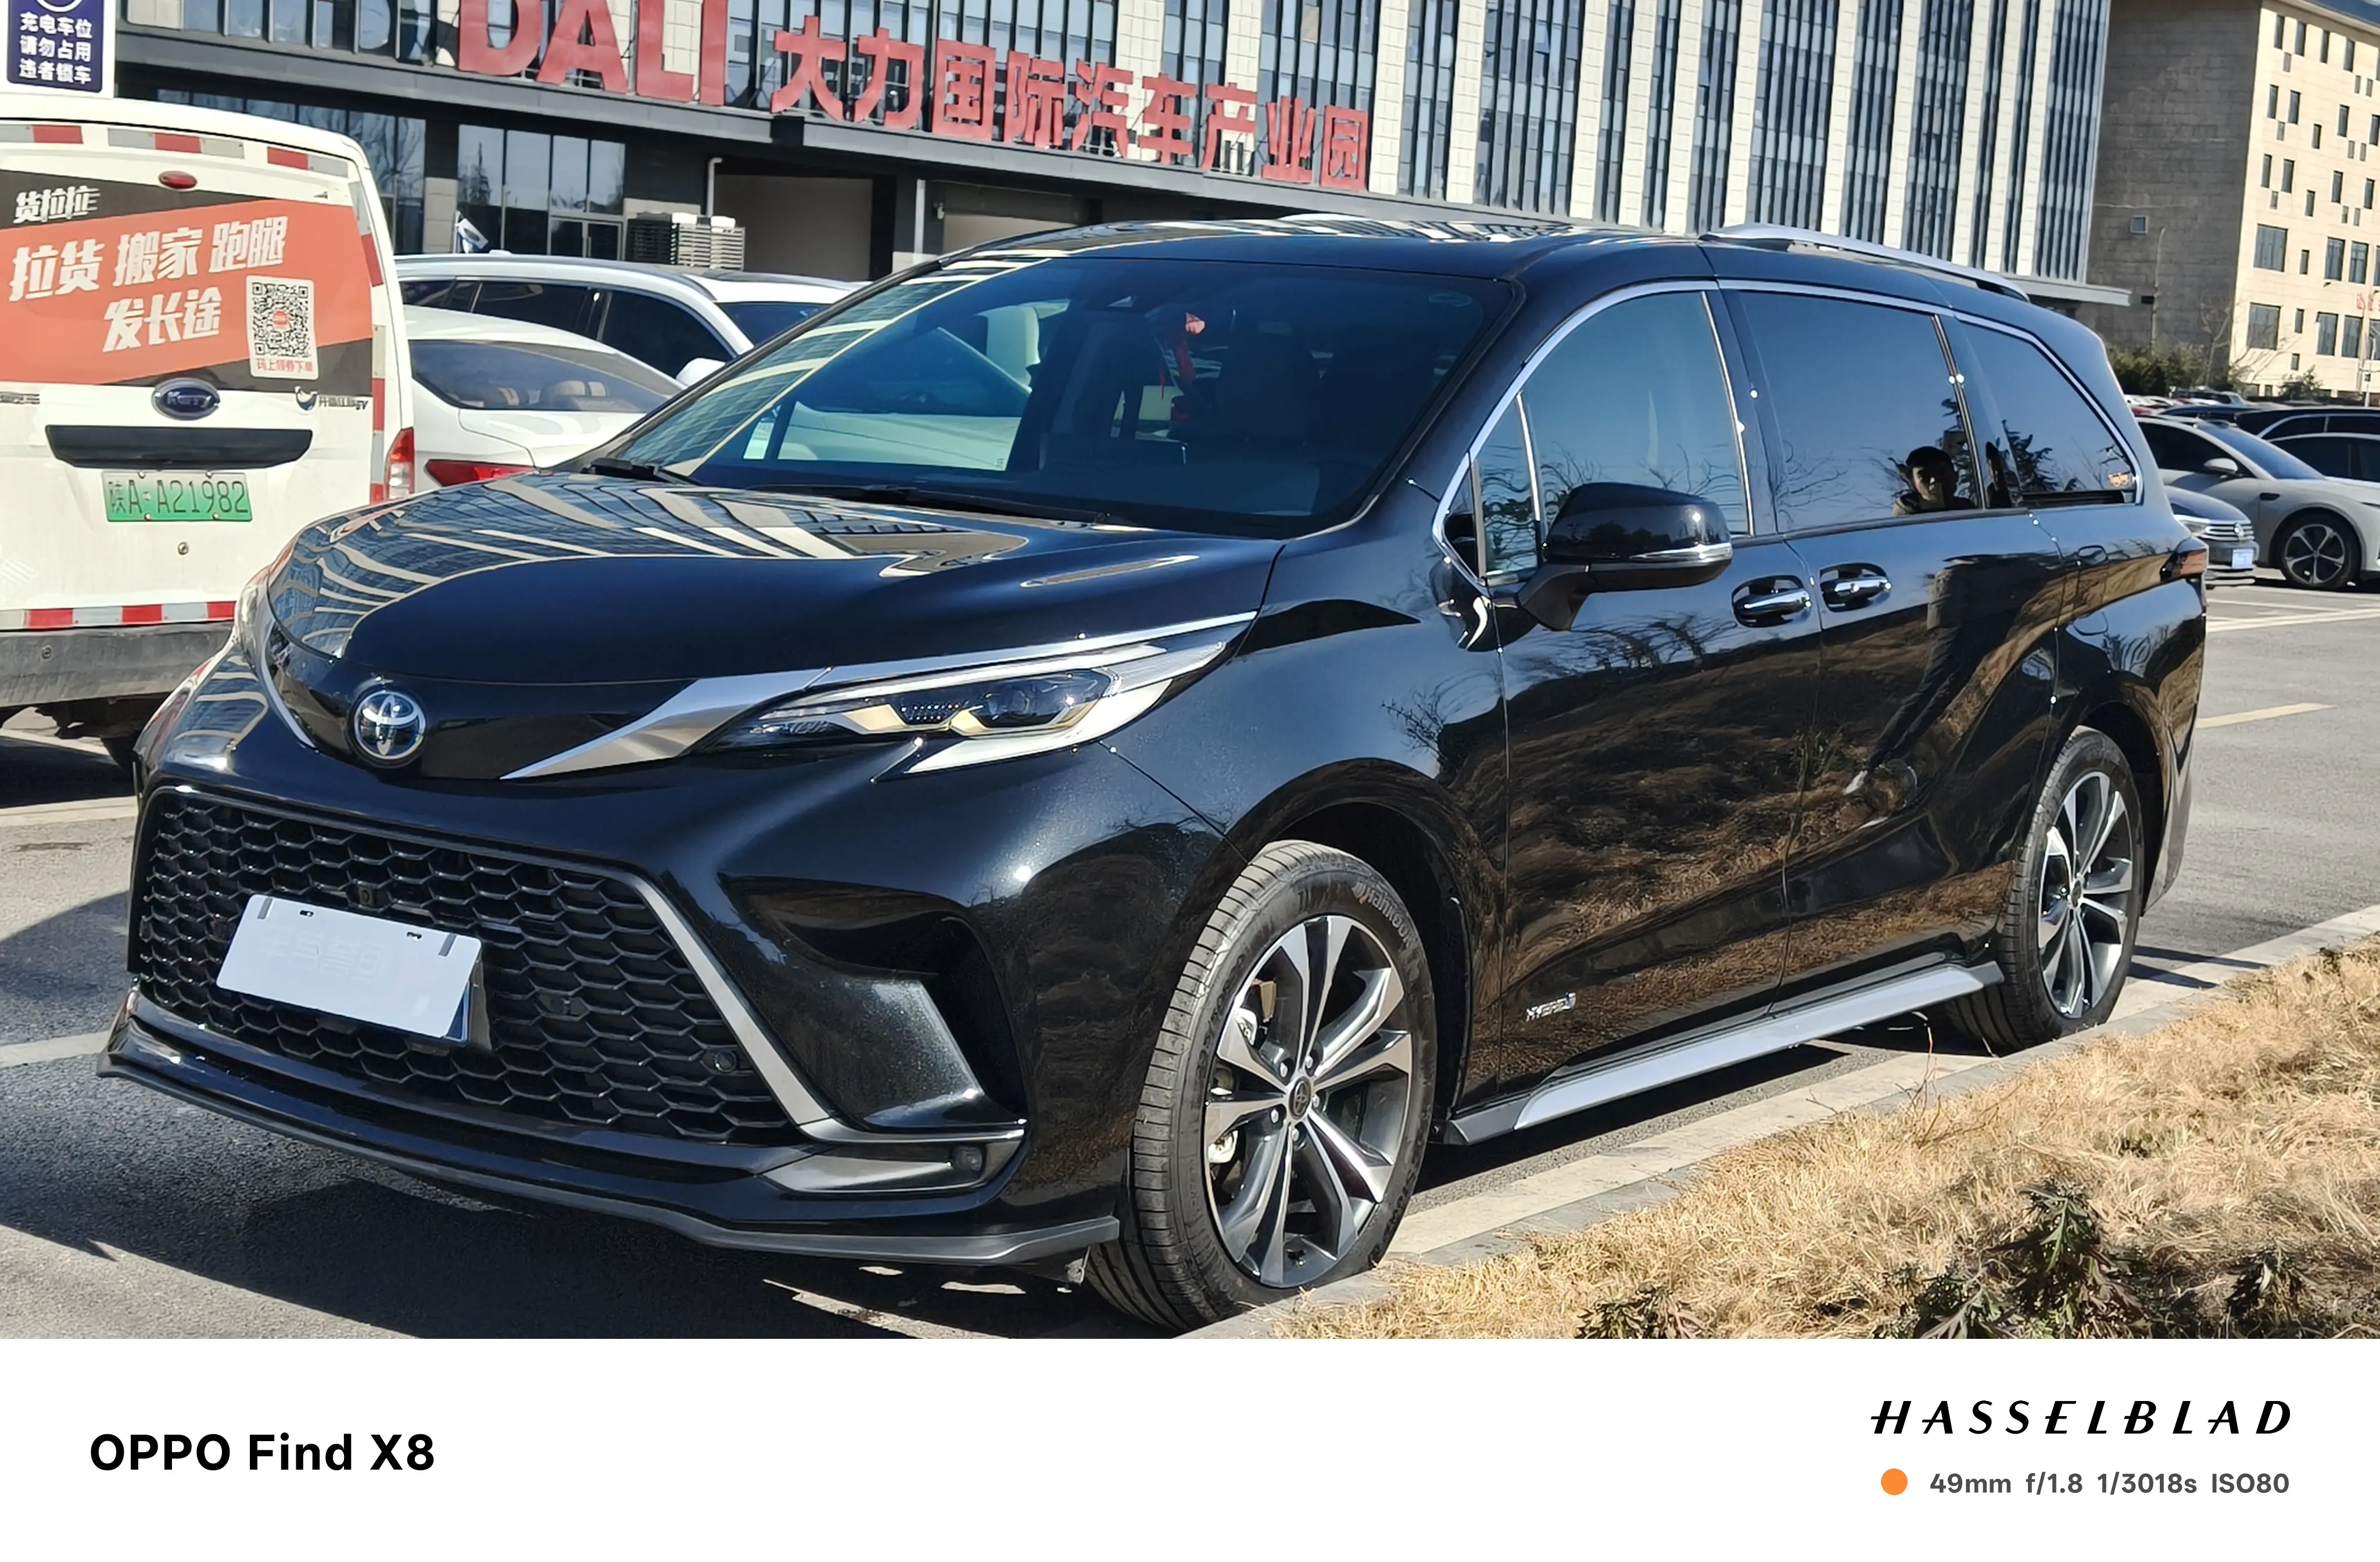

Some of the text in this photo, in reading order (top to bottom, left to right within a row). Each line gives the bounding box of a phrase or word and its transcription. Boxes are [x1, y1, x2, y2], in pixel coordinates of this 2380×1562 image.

[20, 11, 92, 39] 充电车位
[19, 34, 91, 62] 请勿占用
[19, 58, 91, 85] 违者锁车
[458, 0, 1368, 191] DALI 大力国际汽车产业园
[13, 185, 101, 224] 货拉拉
[9, 216, 288, 302] 拉货 搬家 跑腿
[103, 286, 222, 352] 发长途
